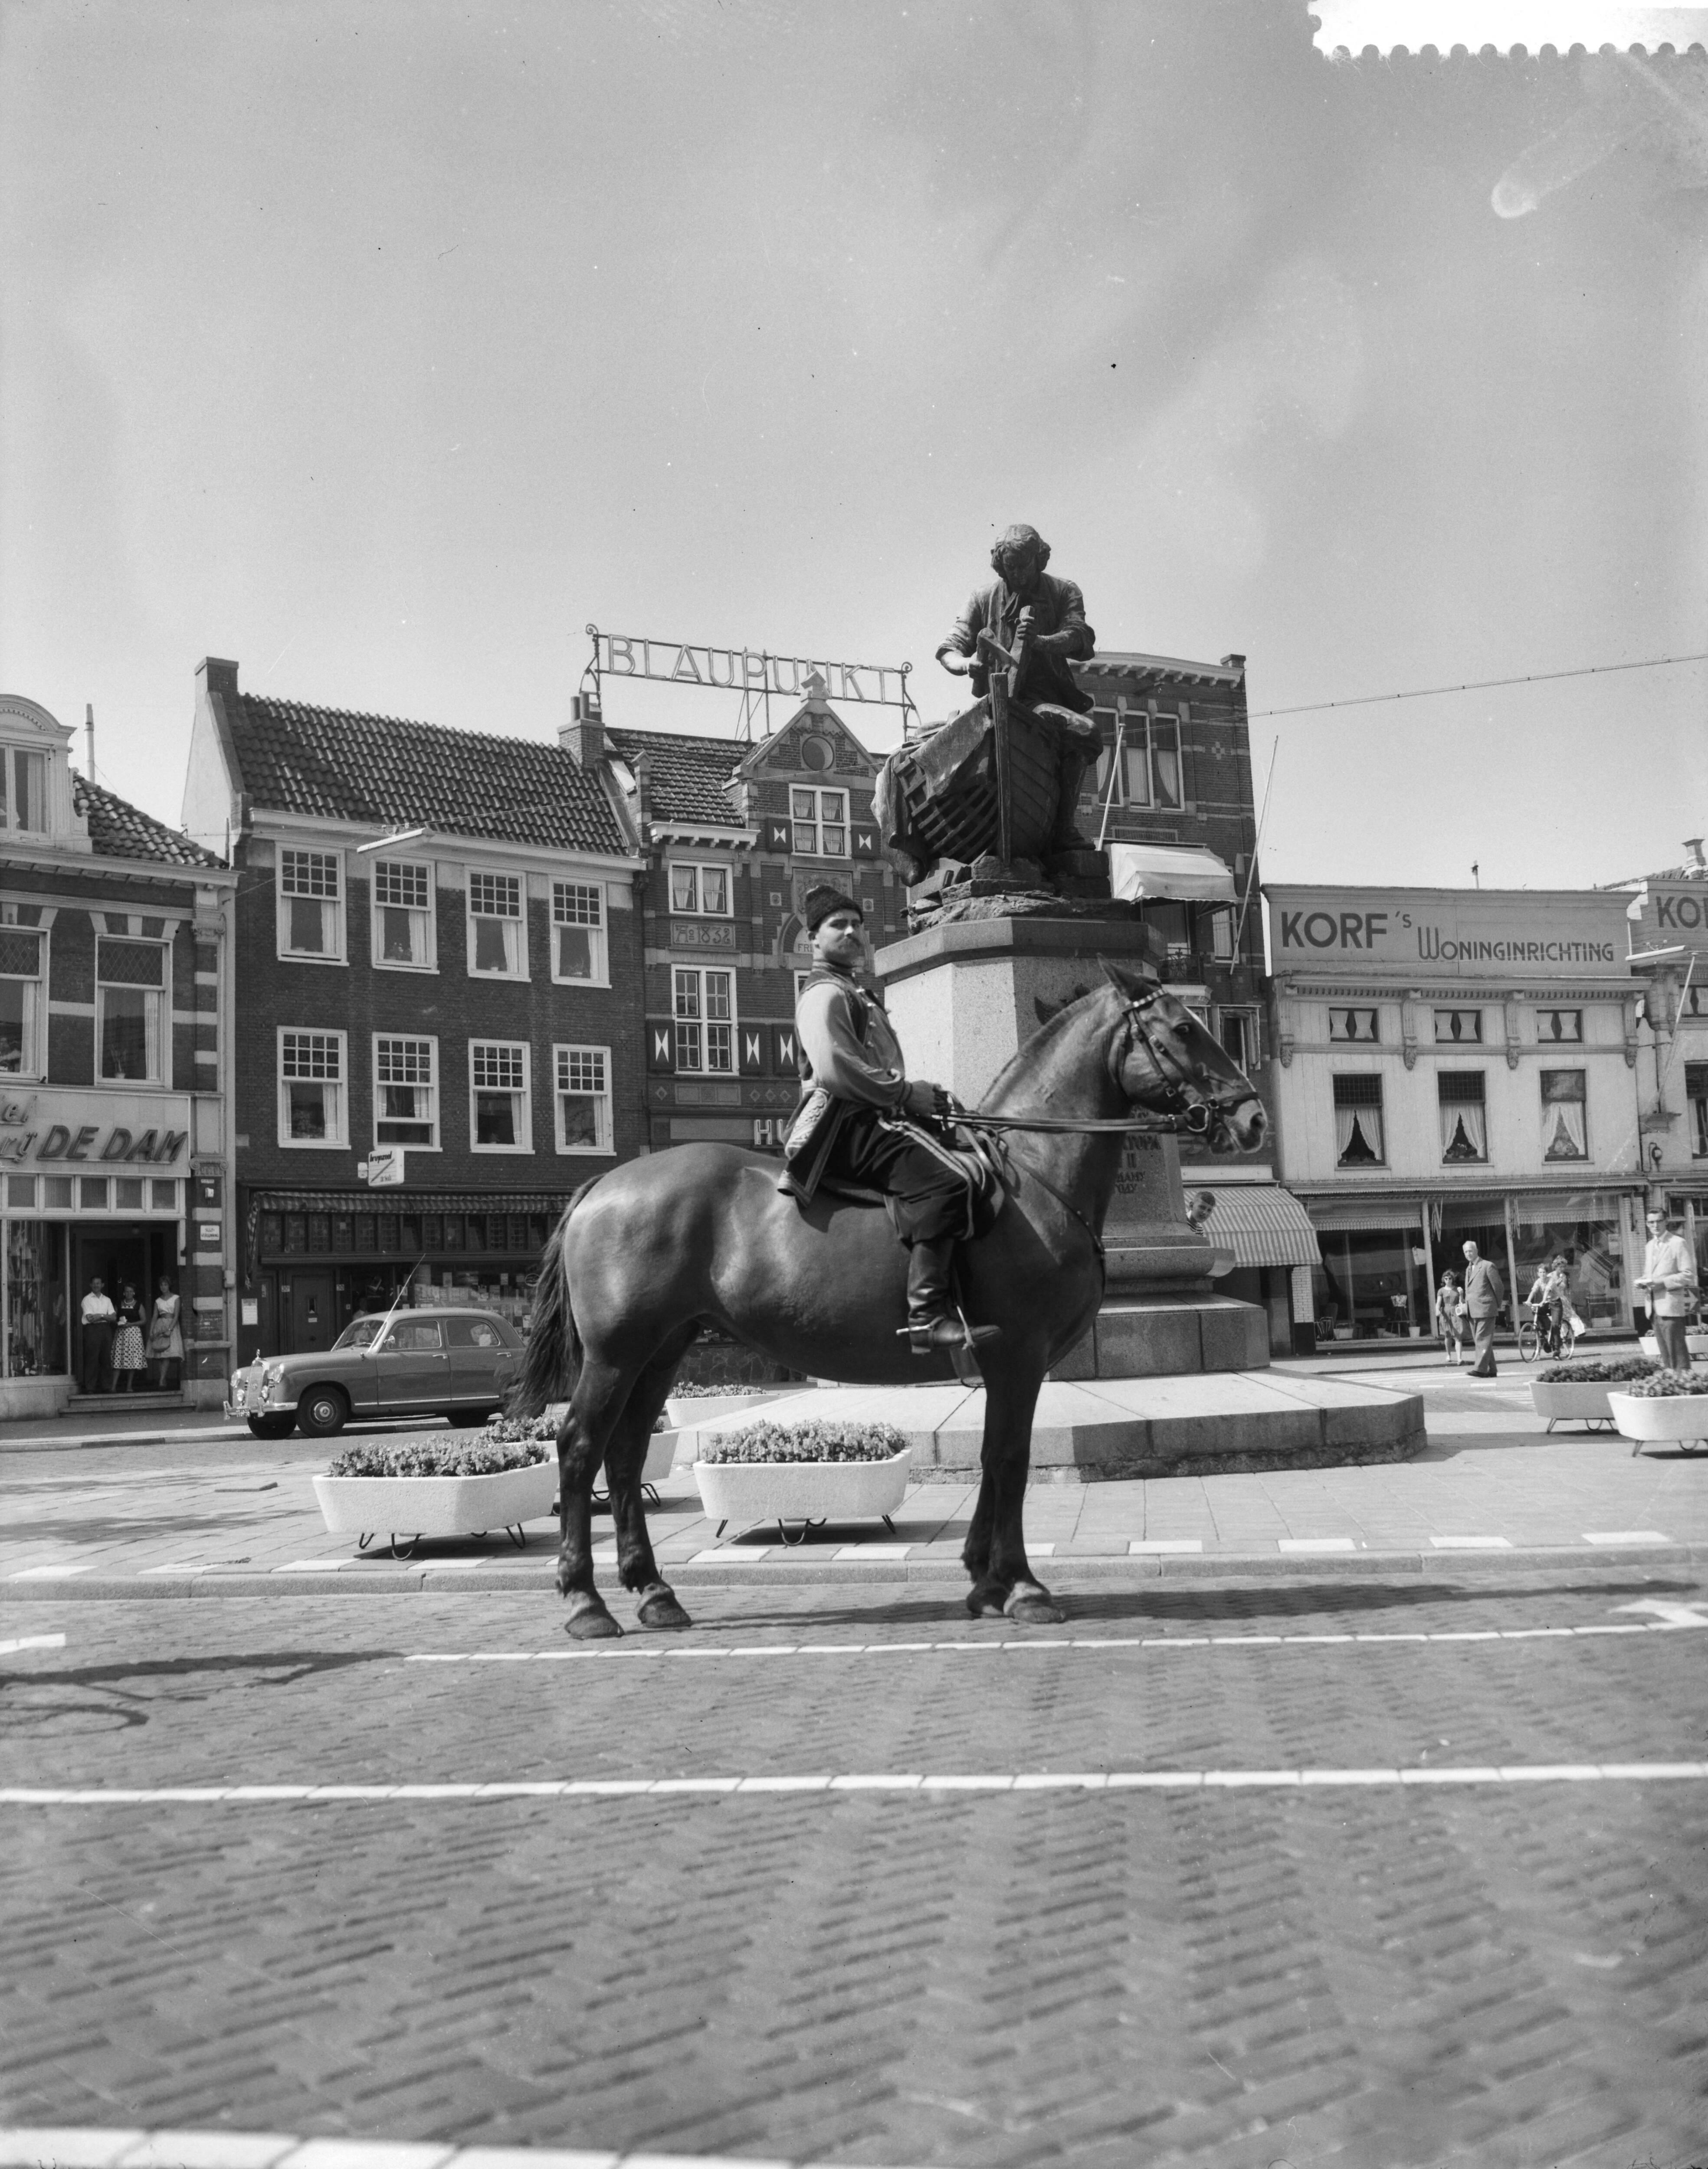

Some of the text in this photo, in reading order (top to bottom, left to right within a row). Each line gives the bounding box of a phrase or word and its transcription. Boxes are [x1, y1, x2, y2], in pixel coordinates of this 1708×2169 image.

[608, 634, 895, 705] BLAUPUNKT
[696, 926, 731, 944] 1832
[36, 1124, 100, 1159] DE
[100, 1127, 188, 1162] DAM
